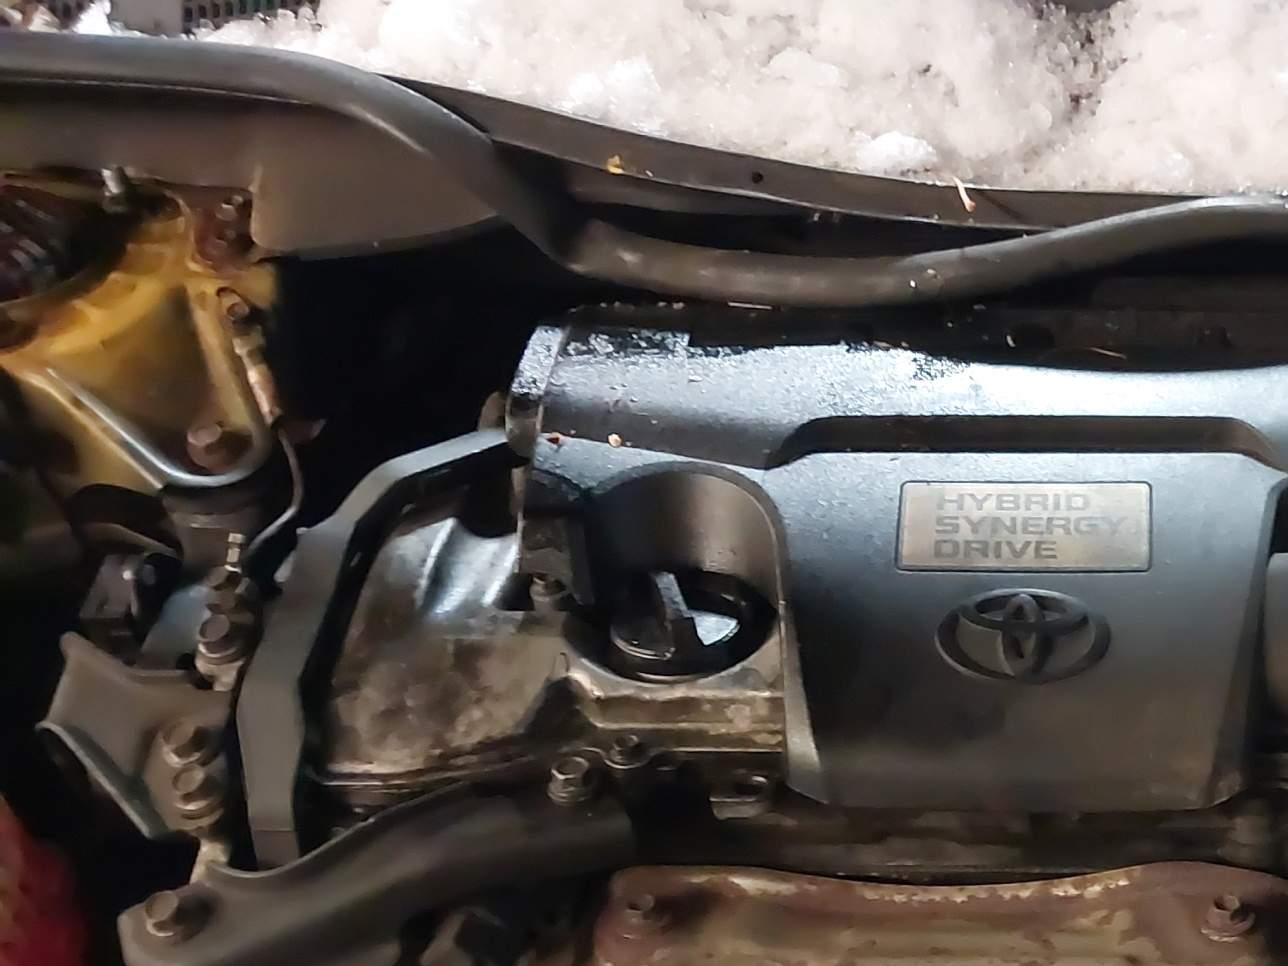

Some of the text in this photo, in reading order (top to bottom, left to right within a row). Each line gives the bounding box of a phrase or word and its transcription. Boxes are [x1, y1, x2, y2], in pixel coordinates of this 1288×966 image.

[936, 492, 1091, 512] HYBRID
[934, 515, 1129, 537] SYNERGY
[933, 539, 1058, 560] DRIVE
